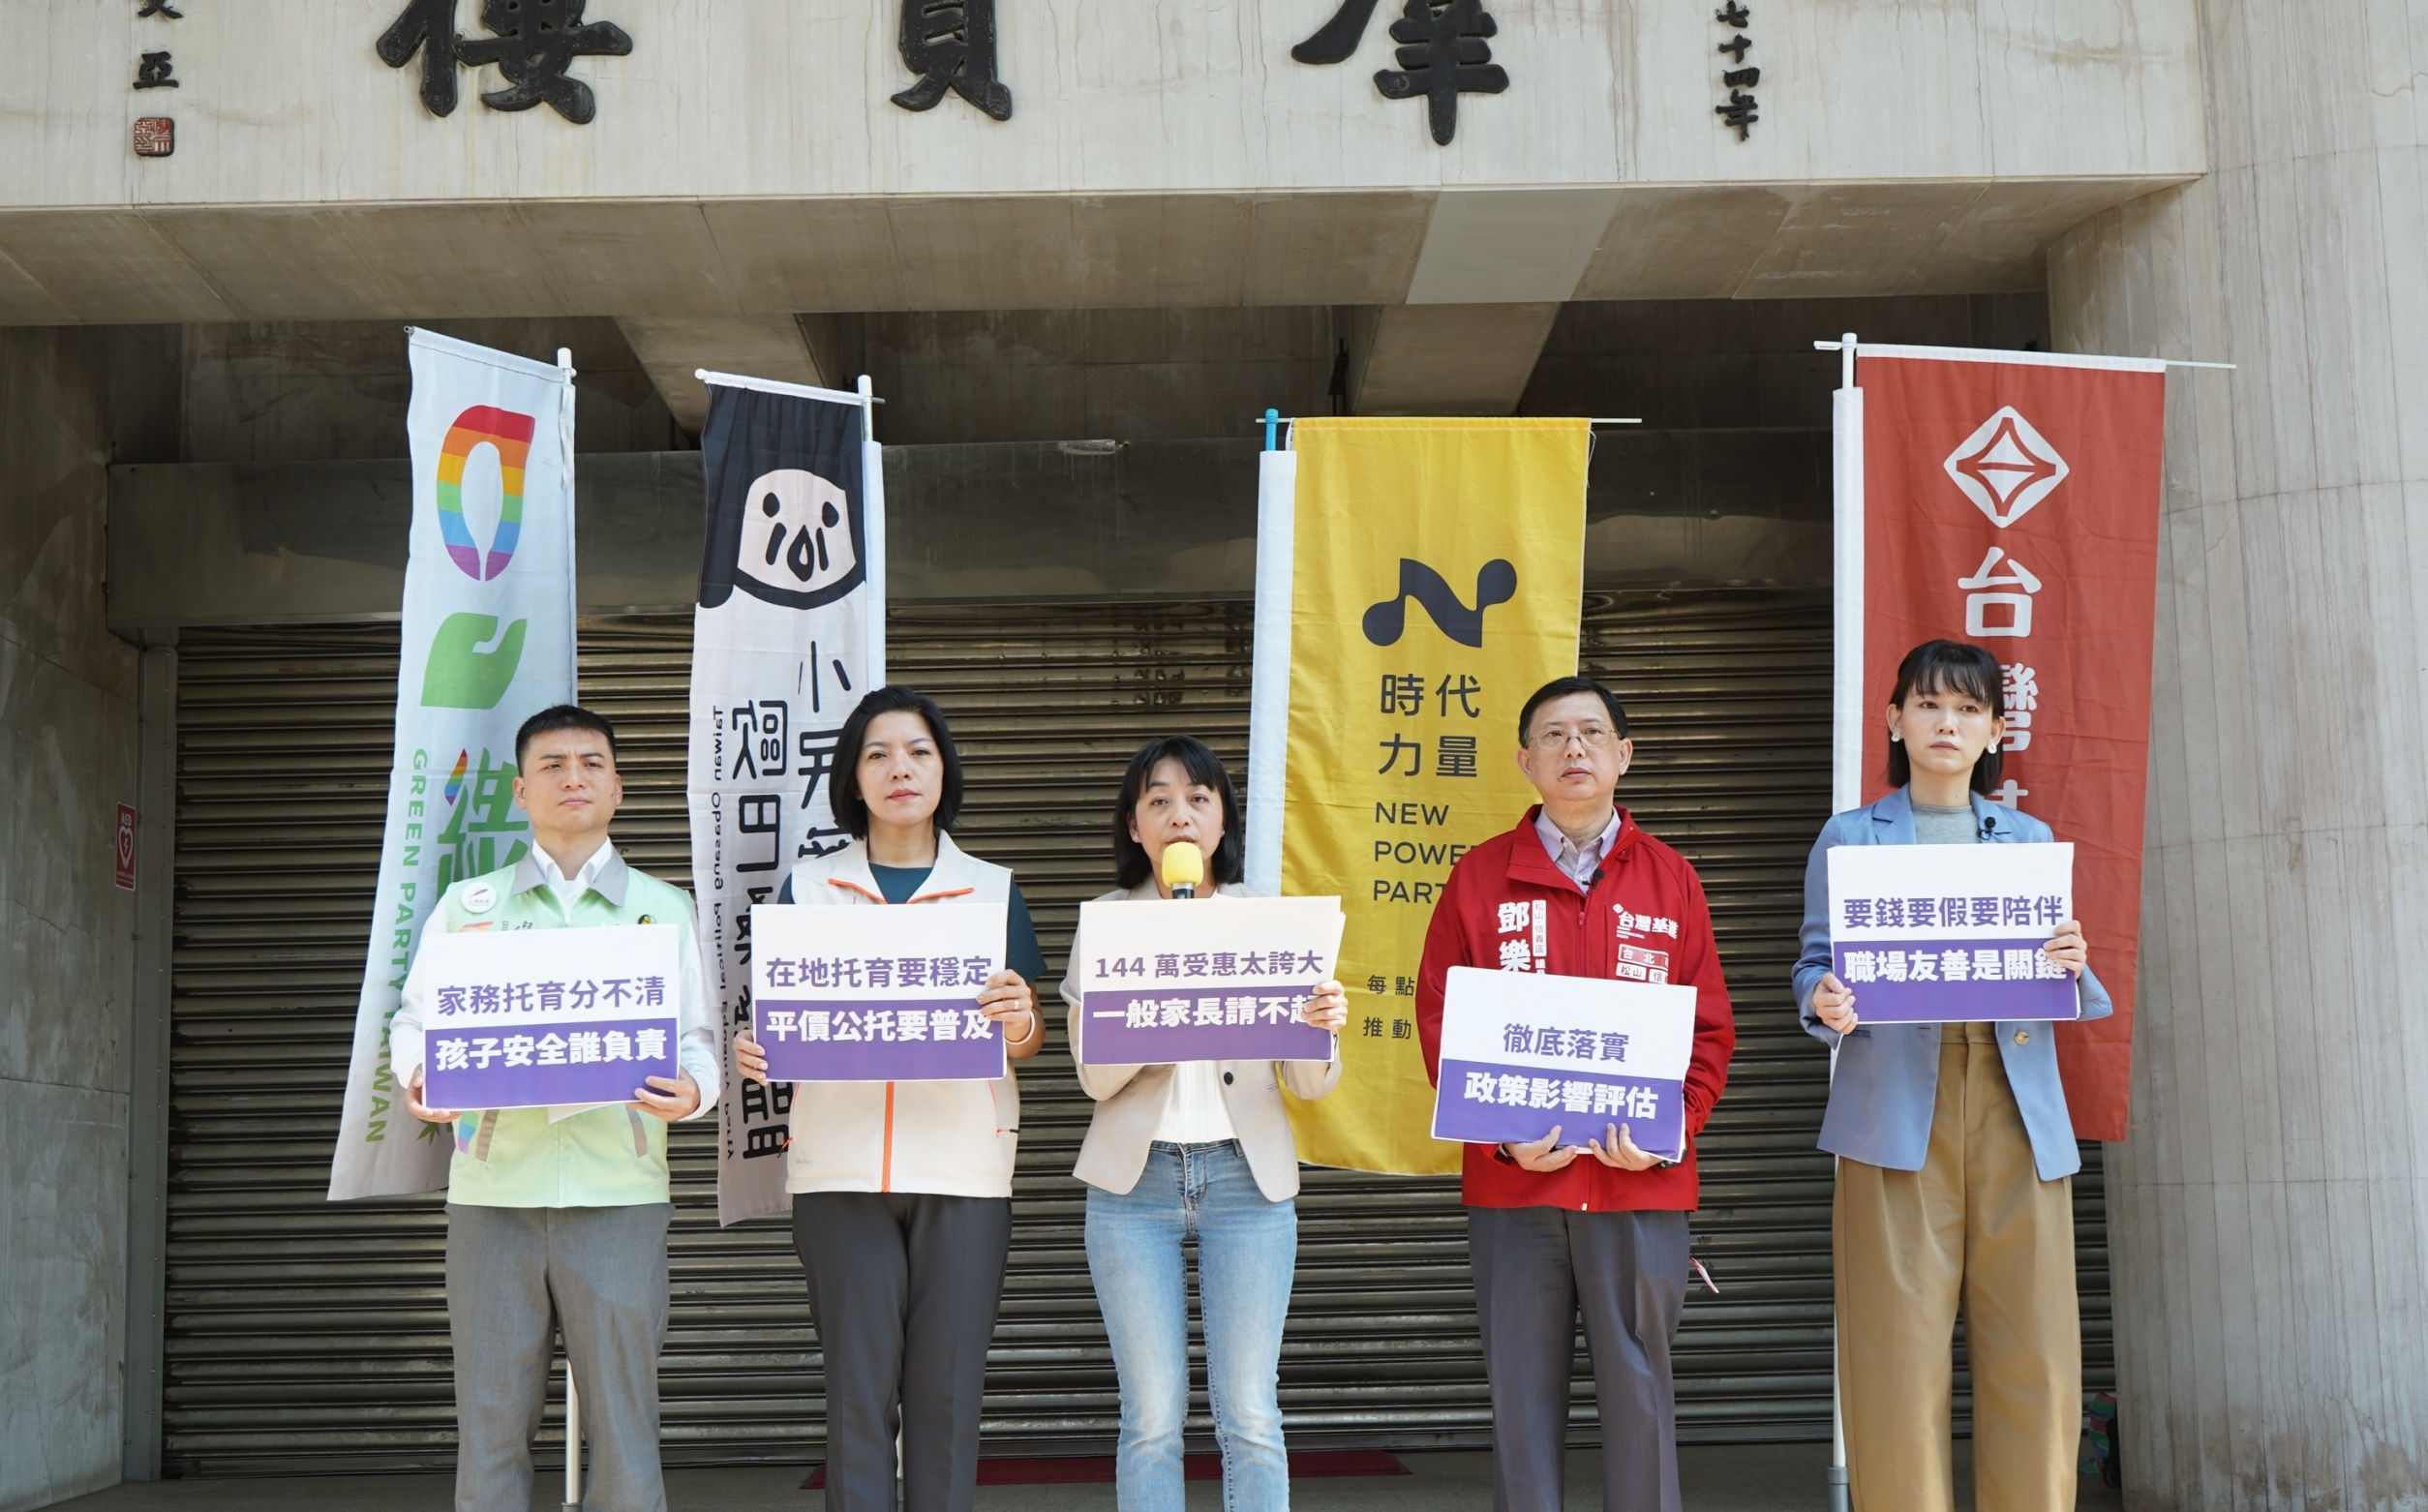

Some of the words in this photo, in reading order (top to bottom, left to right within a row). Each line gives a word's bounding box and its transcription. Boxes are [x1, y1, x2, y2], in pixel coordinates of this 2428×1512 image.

[1380, 673, 1481, 718] 時代
[1378, 733, 1477, 777] 力量
[402, 748, 429, 866] GREEN
[1375, 801, 1449, 826] NEW
[1843, 895, 2064, 928] 要錢要假要陪伴
[387, 882, 416, 991] PARTY
[766, 955, 992, 988] 在地托育要穩定
[1095, 956, 1146, 978] 144
[1155, 950, 1323, 979] 萬受惠太誇大
[1623, 949, 1669, 968] 台北
[1843, 949, 2067, 983] 職場友善是關鍵
[437, 976, 666, 1016] 家務托育分不清
[1366, 974, 1415, 997] 每點
[766, 1009, 994, 1042] 平價公托要普及
[1362, 1015, 1411, 1040] 推動
[1502, 1022, 1629, 1062] 徹底落實
[436, 1028, 667, 1072] 孩子安全誰負責
[1464, 1071, 1659, 1120] 政策影響評估
